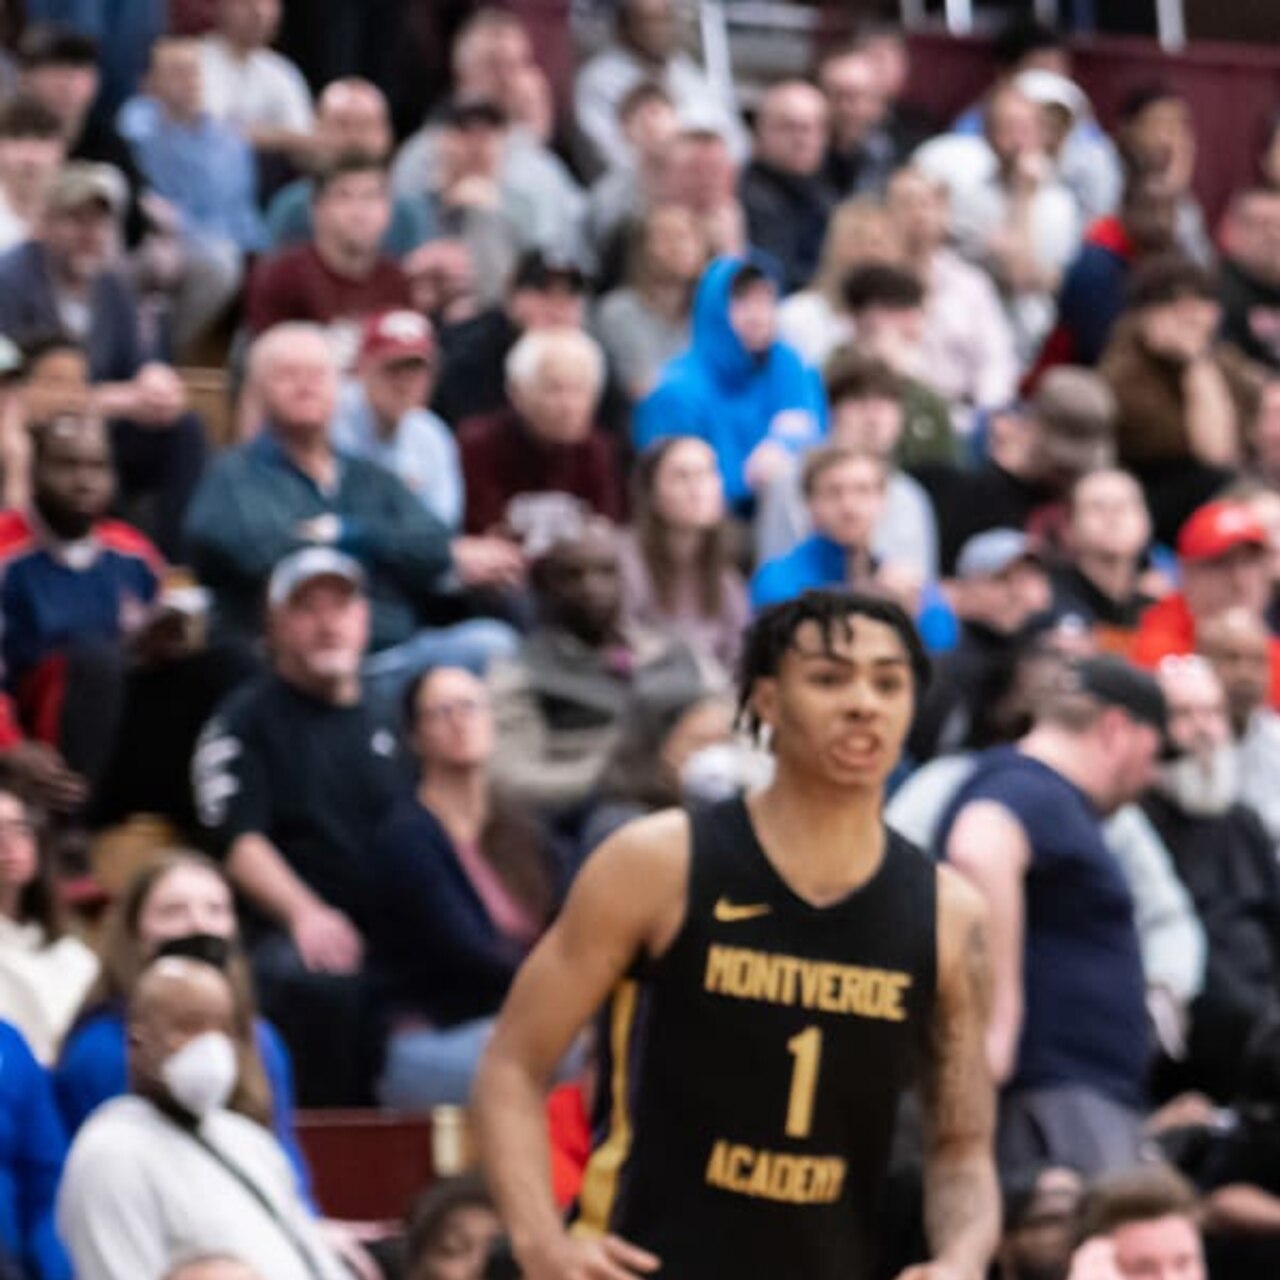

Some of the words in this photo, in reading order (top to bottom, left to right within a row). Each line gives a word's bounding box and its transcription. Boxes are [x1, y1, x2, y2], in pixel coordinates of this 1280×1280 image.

[704, 943, 913, 1023] MONTVERDE
[786, 1025, 822, 1138] 1
[706, 1139, 847, 1205] ACADEMY
